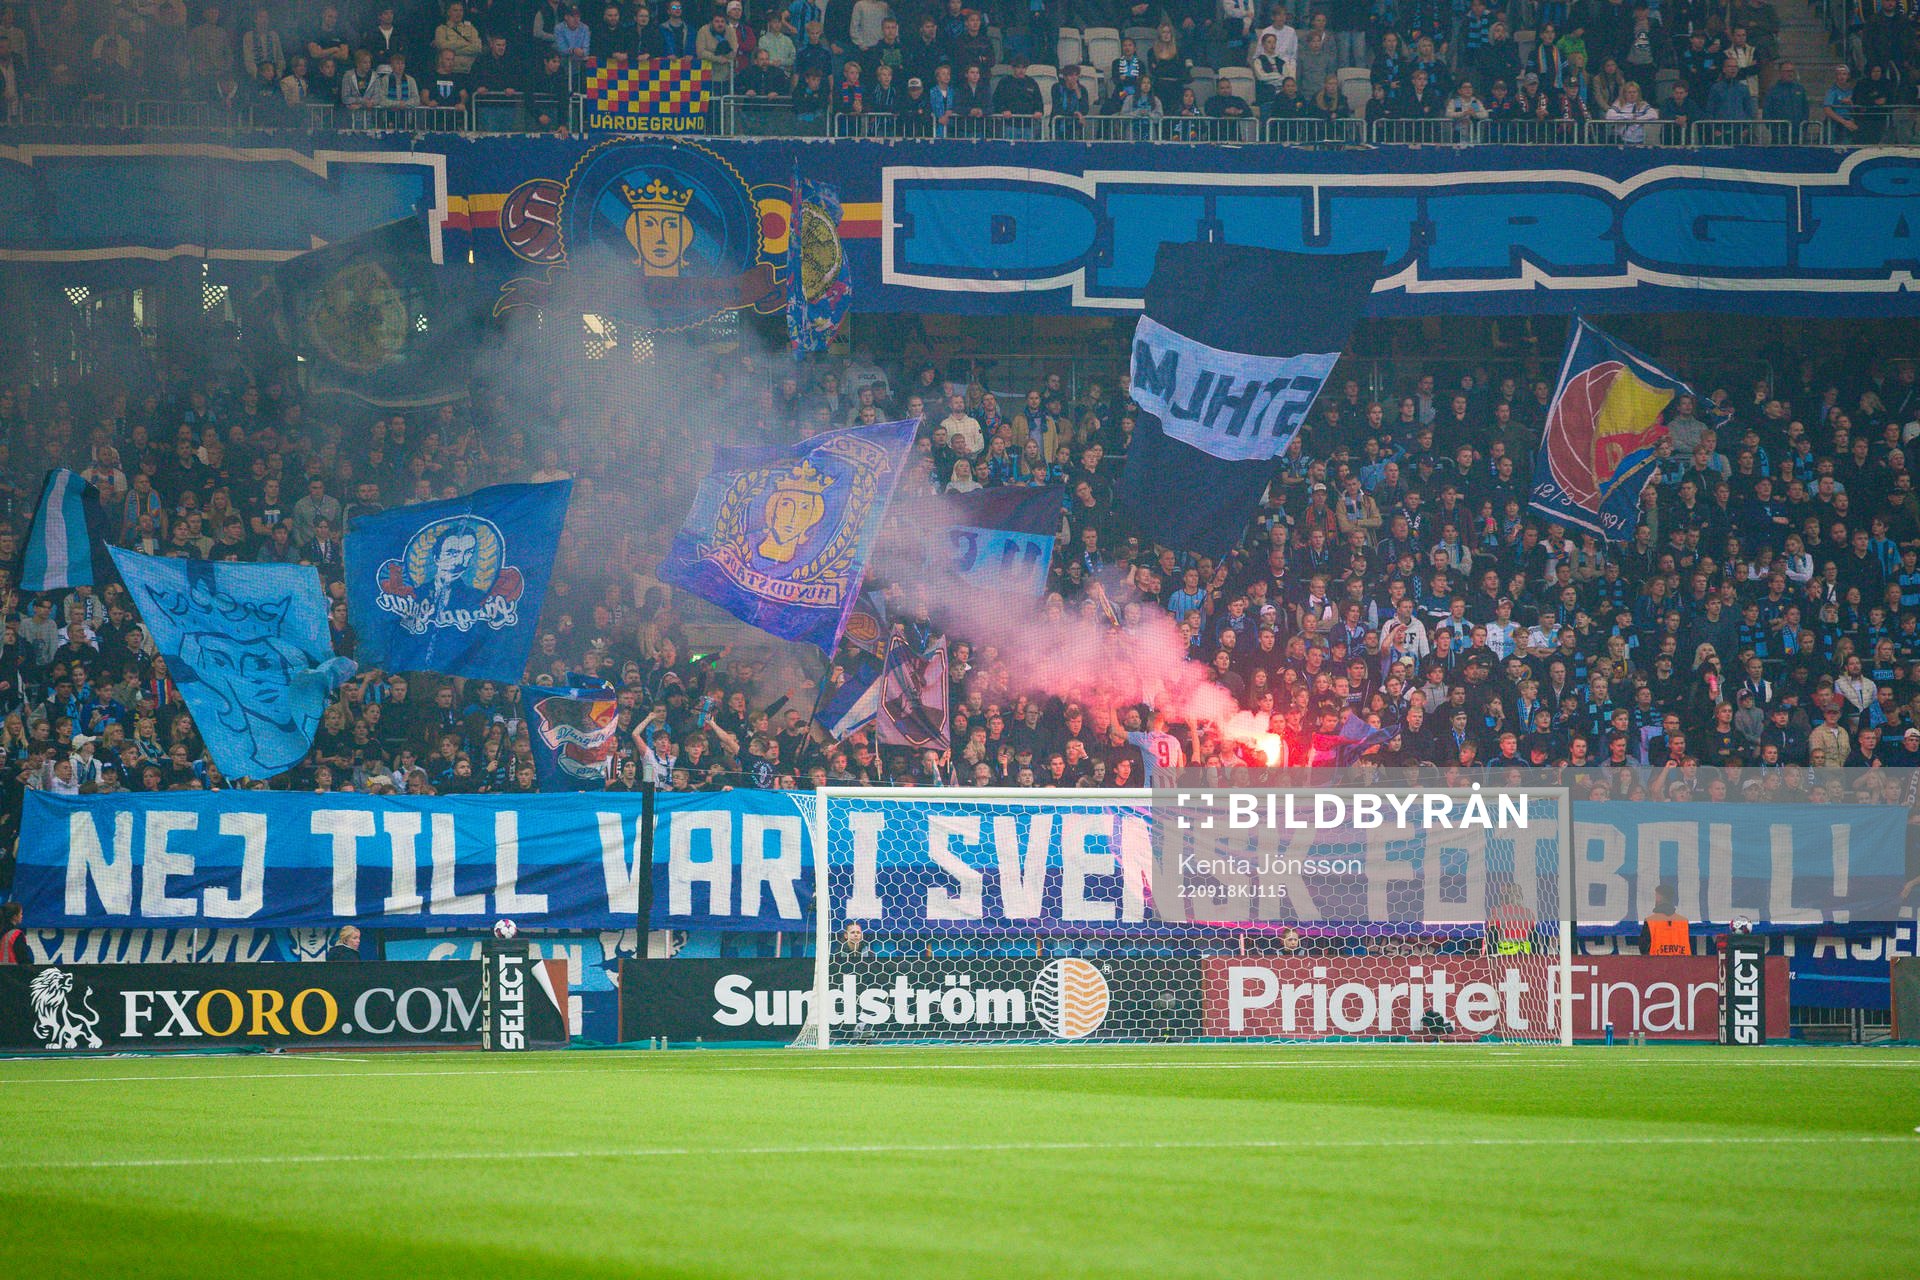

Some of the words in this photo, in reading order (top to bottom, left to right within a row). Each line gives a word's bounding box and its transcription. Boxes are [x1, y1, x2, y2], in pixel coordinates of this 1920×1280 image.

[1158, 740, 1170, 768] 9
[64, 810, 268, 919] NEJ
[310, 809, 549, 916] TILL
[595, 810, 803, 920] VAR
[845, 811, 886, 921] I
[119, 986, 484, 1038] FXORO.COM
[482, 954, 492, 1050] SELECT
[499, 954, 525, 1050] SELECT
[712, 973, 1026, 1027] Sundström
[1228, 966, 1530, 1033] Prioritet
[1718, 950, 1728, 1043] SELECT
[1734, 950, 1759, 1044] SELECT
